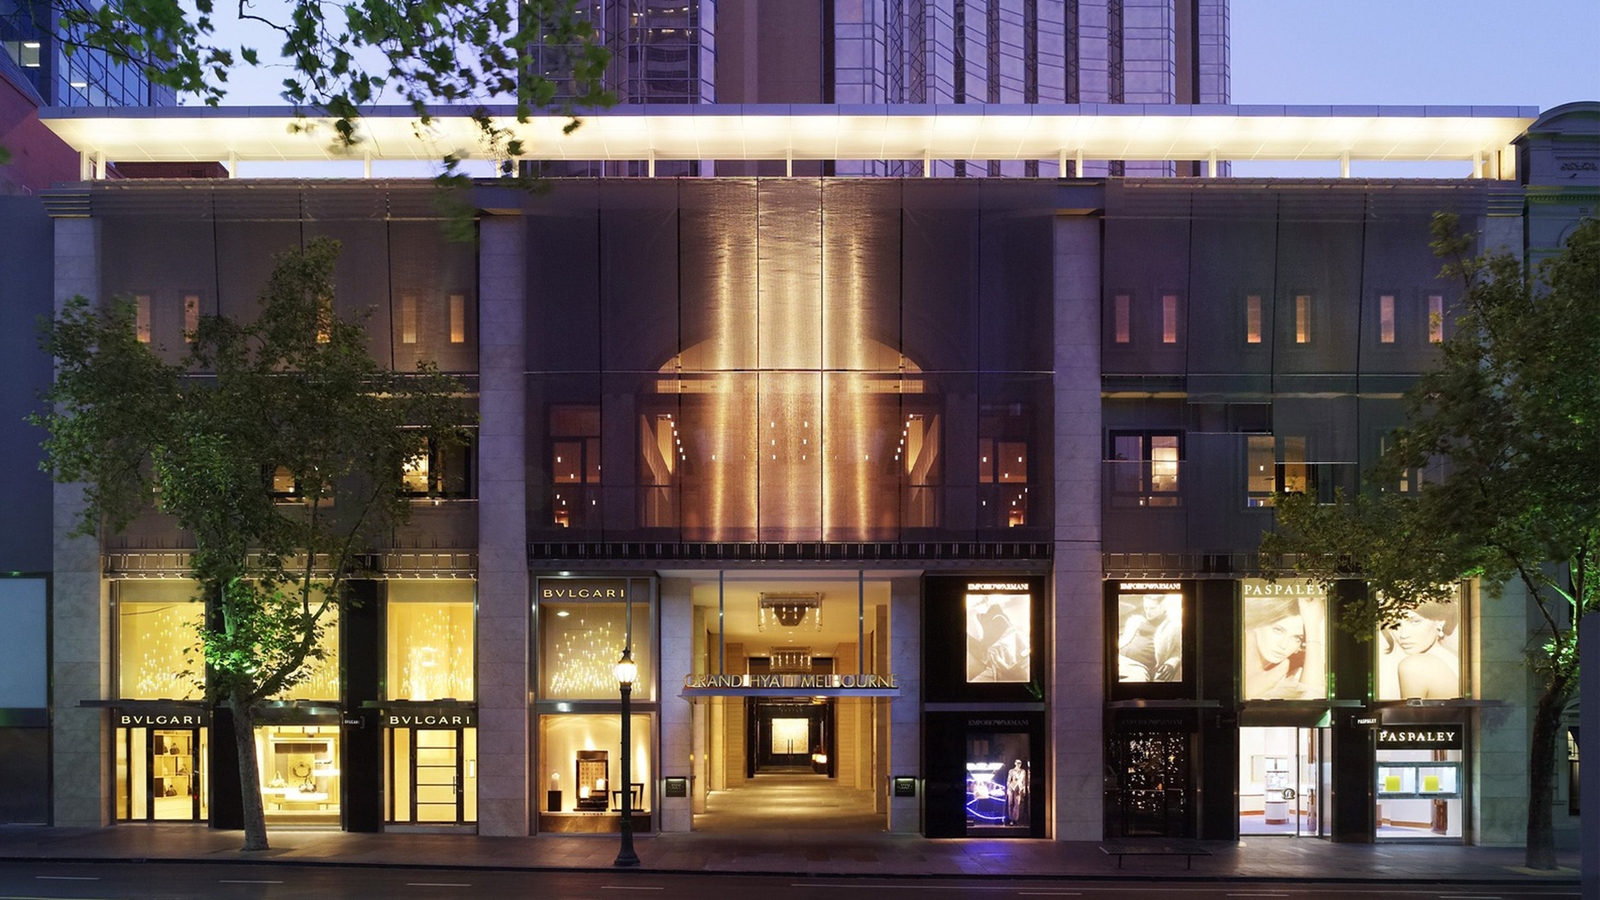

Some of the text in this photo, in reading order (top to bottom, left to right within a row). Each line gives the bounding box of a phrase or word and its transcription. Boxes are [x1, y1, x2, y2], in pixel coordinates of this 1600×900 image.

[543, 589, 624, 598] BVLGARI
[1244, 584, 1326, 595] PASPALEY
[684, 674, 898, 688] GRAND HYATT MELBOURNE
[121, 715, 201, 725] BVLGARI
[389, 715, 470, 725] BVLGARI
[1379, 731, 1455, 742] PASPALEY
